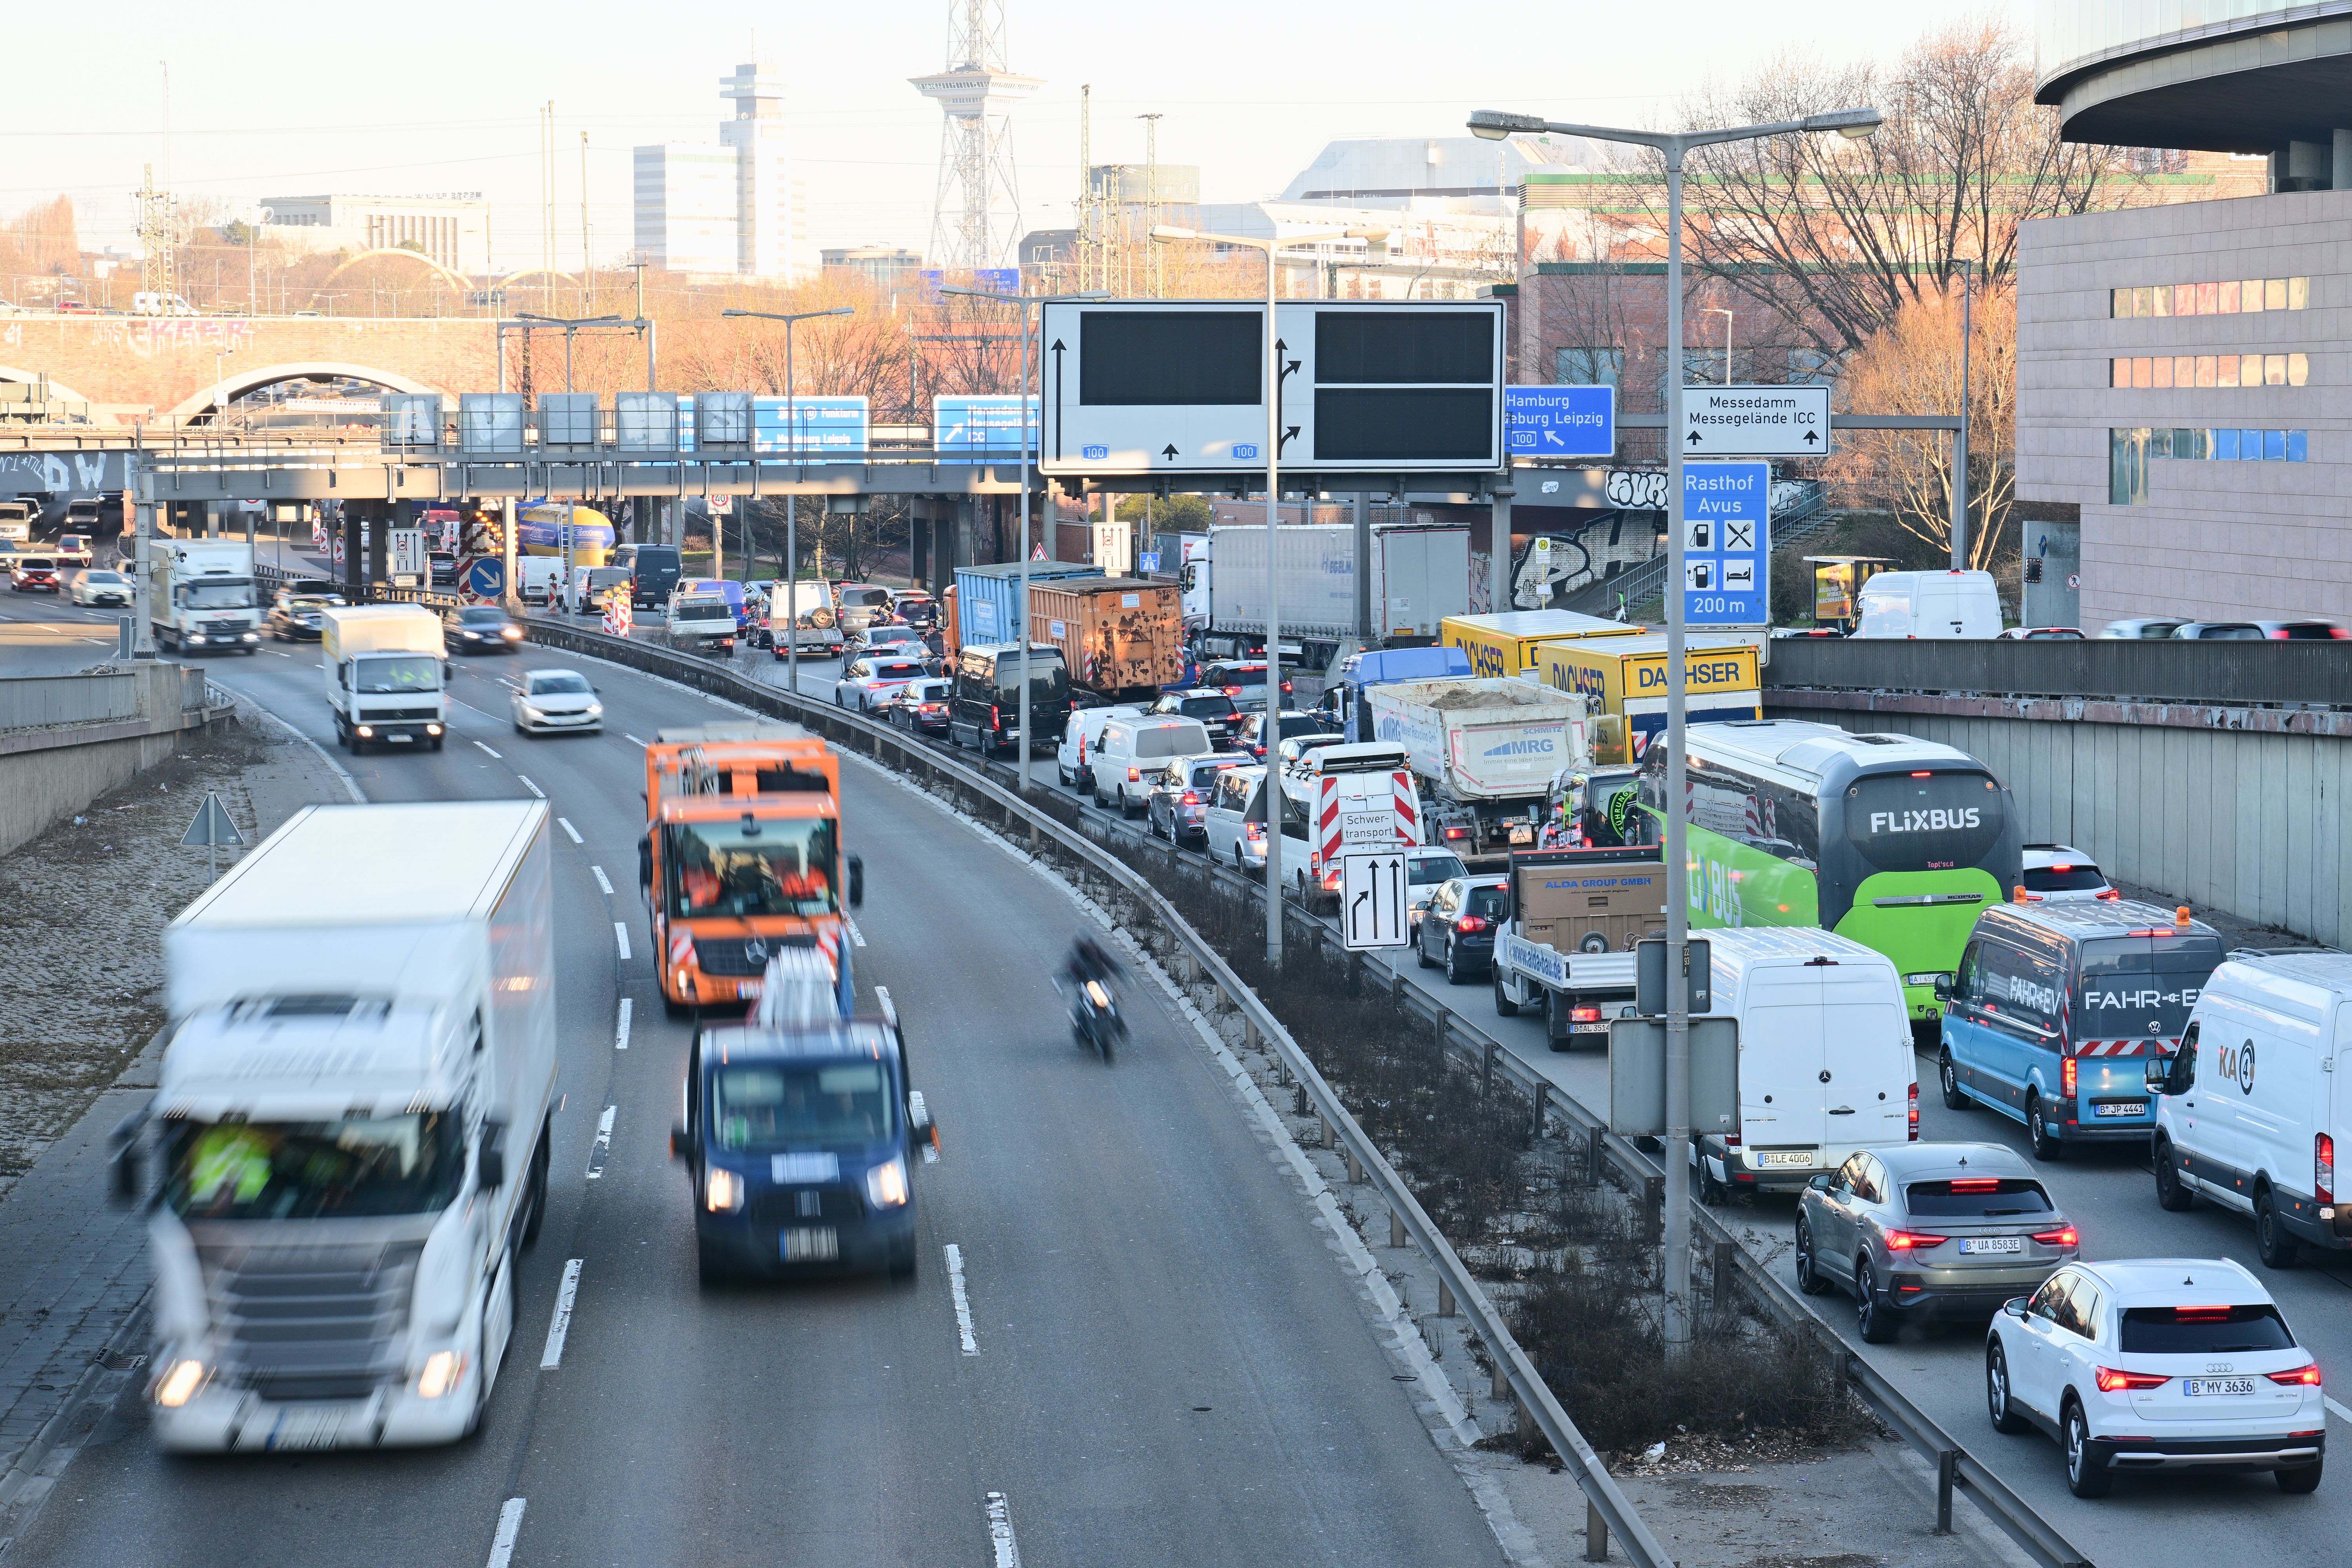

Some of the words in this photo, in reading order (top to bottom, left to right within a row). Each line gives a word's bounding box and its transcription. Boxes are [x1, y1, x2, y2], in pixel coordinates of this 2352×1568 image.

[1506, 394, 1569, 409] Hamburg
[1710, 396, 1796, 408] Messedamm
[821, 407, 858, 418] Funkturm
[1555, 412, 1603, 427] Leipzig
[1690, 412, 1787, 427] Messegelände
[1794, 412, 1815, 424] ICC
[777, 434, 820, 446] Madeburg
[823, 433, 850, 446] Leipzig
[967, 432, 985, 442] ICC
[1515, 434, 1532, 443] 100
[1087, 448, 1104, 458] 100
[1236, 447, 1253, 457] 100
[1686, 475, 1754, 490] Rasthof
[1697, 497, 1742, 513] Avus
[1694, 597, 1725, 613] 200
[1729, 601, 1745, 612] m
[1639, 662, 1739, 688] DAHSER
[1386, 716, 1401, 742] MRG
[1523, 726, 1562, 735] SCHMITZ
[1511, 739, 1553, 754] MRG
[1347, 815, 1389, 824] Schwer-
[1346, 827, 1392, 839] transport
[1515, 826, 1526, 840] A
[1582, 879, 1618, 887] GROUP
[1620, 877, 1651, 886] GMBH
[1684, 947, 1690, 956] 22
[1512, 944, 1561, 981] www.alda-bau.de
[1684, 956, 1690, 965] 93
[2219, 1044, 2238, 1082] KA
[2243, 1058, 2249, 1080] 4
[2100, 1105, 2105, 1114] B
[2111, 1105, 2122, 1113] JP
[2123, 1104, 2144, 1113] 4441
[1764, 1155, 1770, 1163] B
[1776, 1154, 1787, 1163] LE
[1789, 1154, 1810, 1163] 4006
[1966, 1240, 1971, 1250] B
[1978, 1240, 1989, 1250] UA
[1992, 1239, 2019, 1250] 8583E
[2192, 1382, 2200, 1394] B
[2207, 1381, 2221, 1393] MY
[2225, 1381, 2253, 1392] 3636
